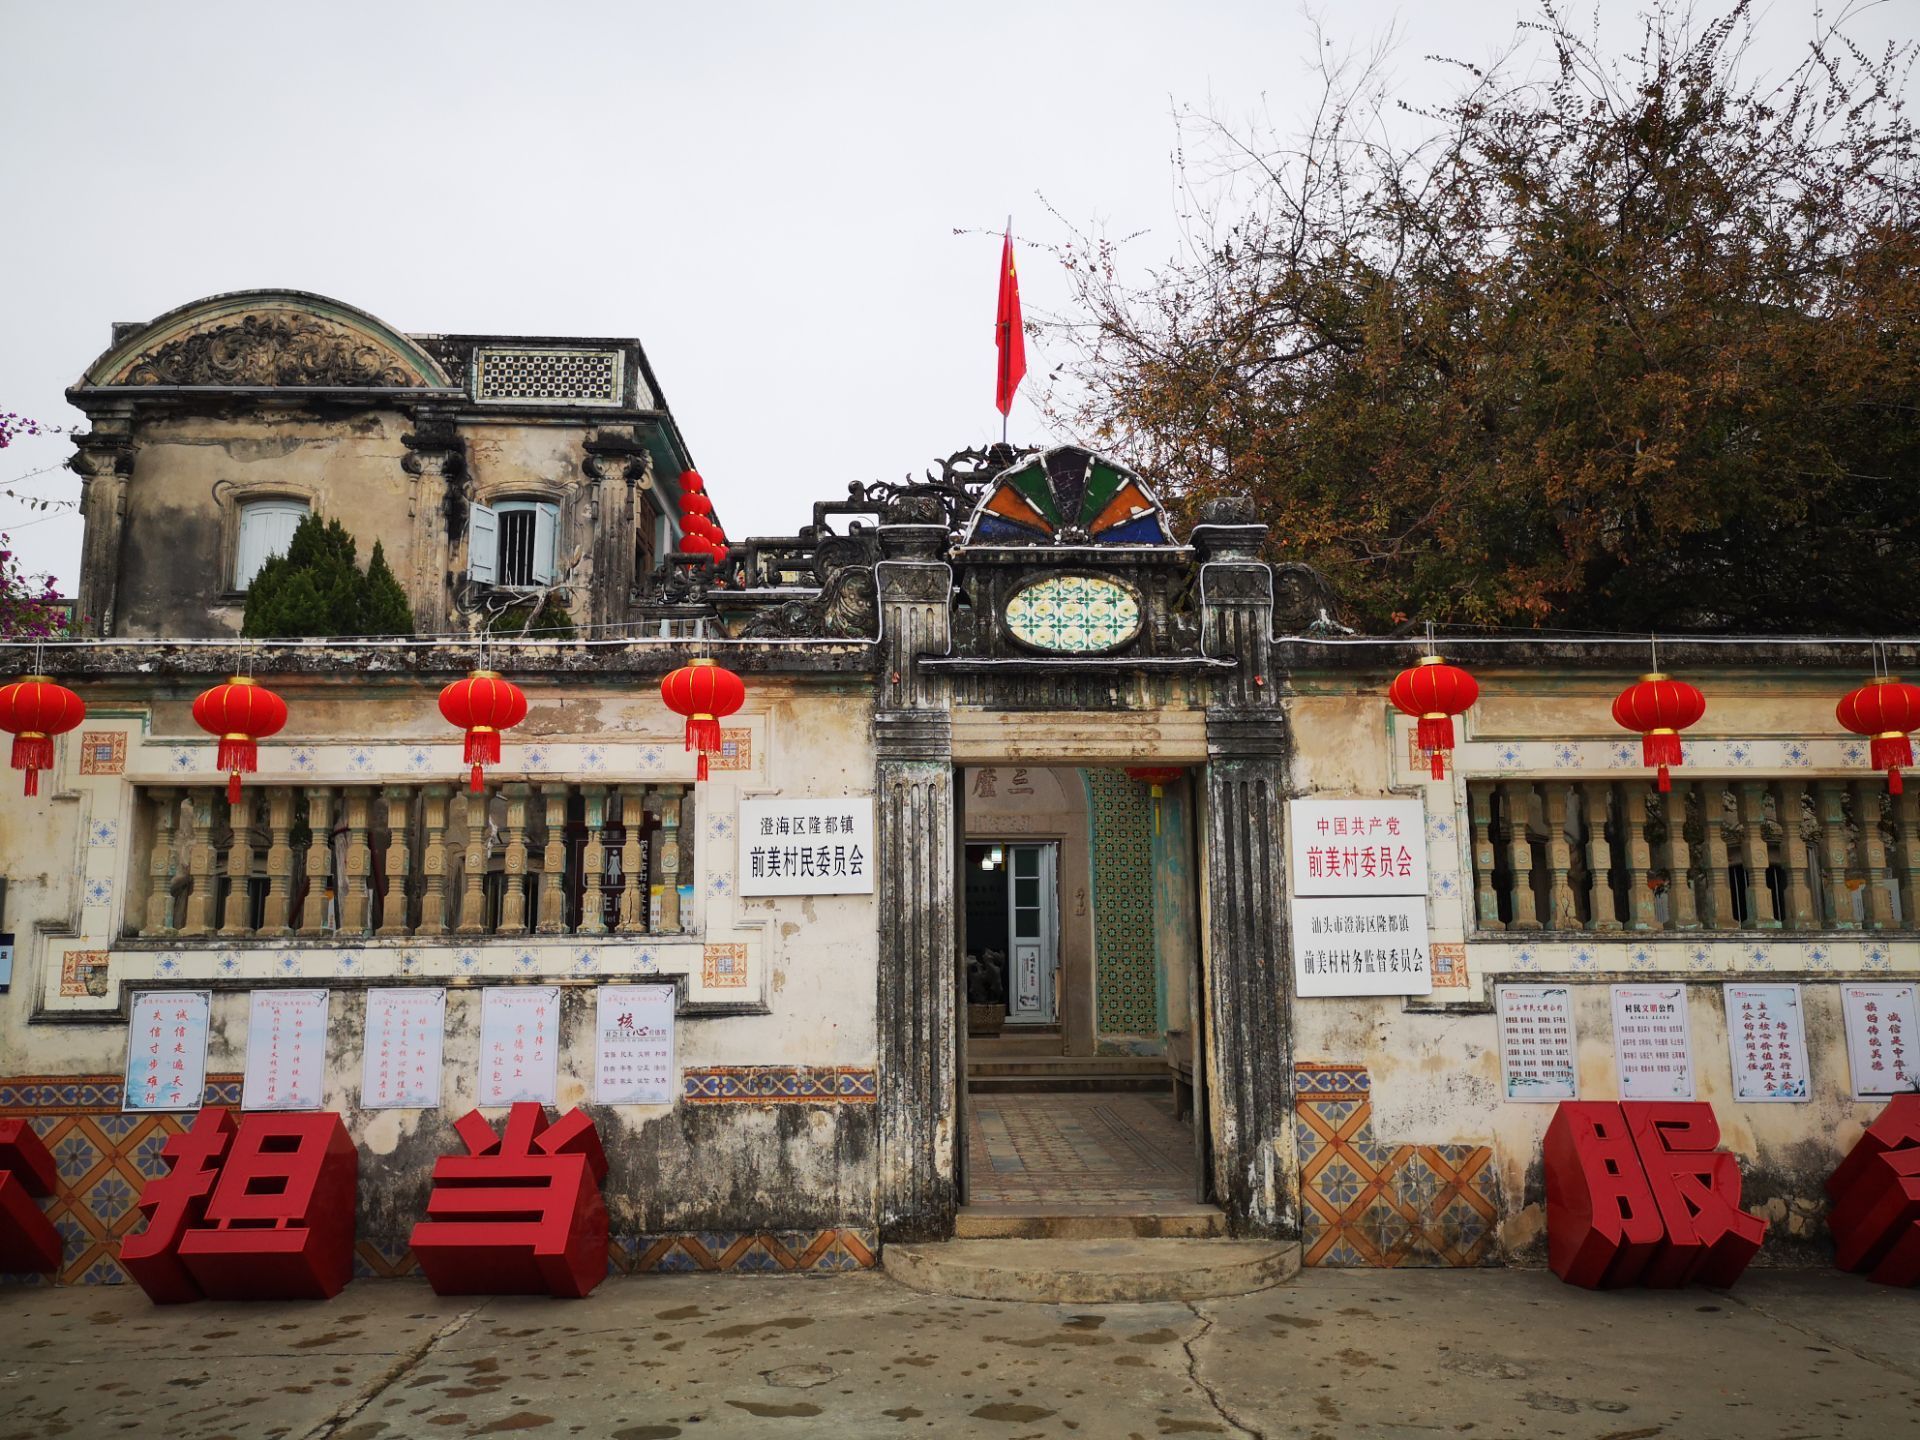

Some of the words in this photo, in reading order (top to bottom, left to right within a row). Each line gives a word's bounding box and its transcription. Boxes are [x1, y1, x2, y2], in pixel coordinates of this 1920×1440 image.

[761, 815, 854, 836] 澄海区隆都镇
[1317, 817, 1400, 836] 中国共产党
[750, 844, 864, 878] 前美村民委员会
[1307, 846, 1412, 878] 前美村委员会
[1312, 915, 1410, 934] 汕头市澄海区隆都镇
[1304, 948, 1424, 975] 前美村村务监督委员会
[1625, 1004, 1675, 1013] 村民文明公约
[170, 1009, 189, 1103] 诚信走遍天下
